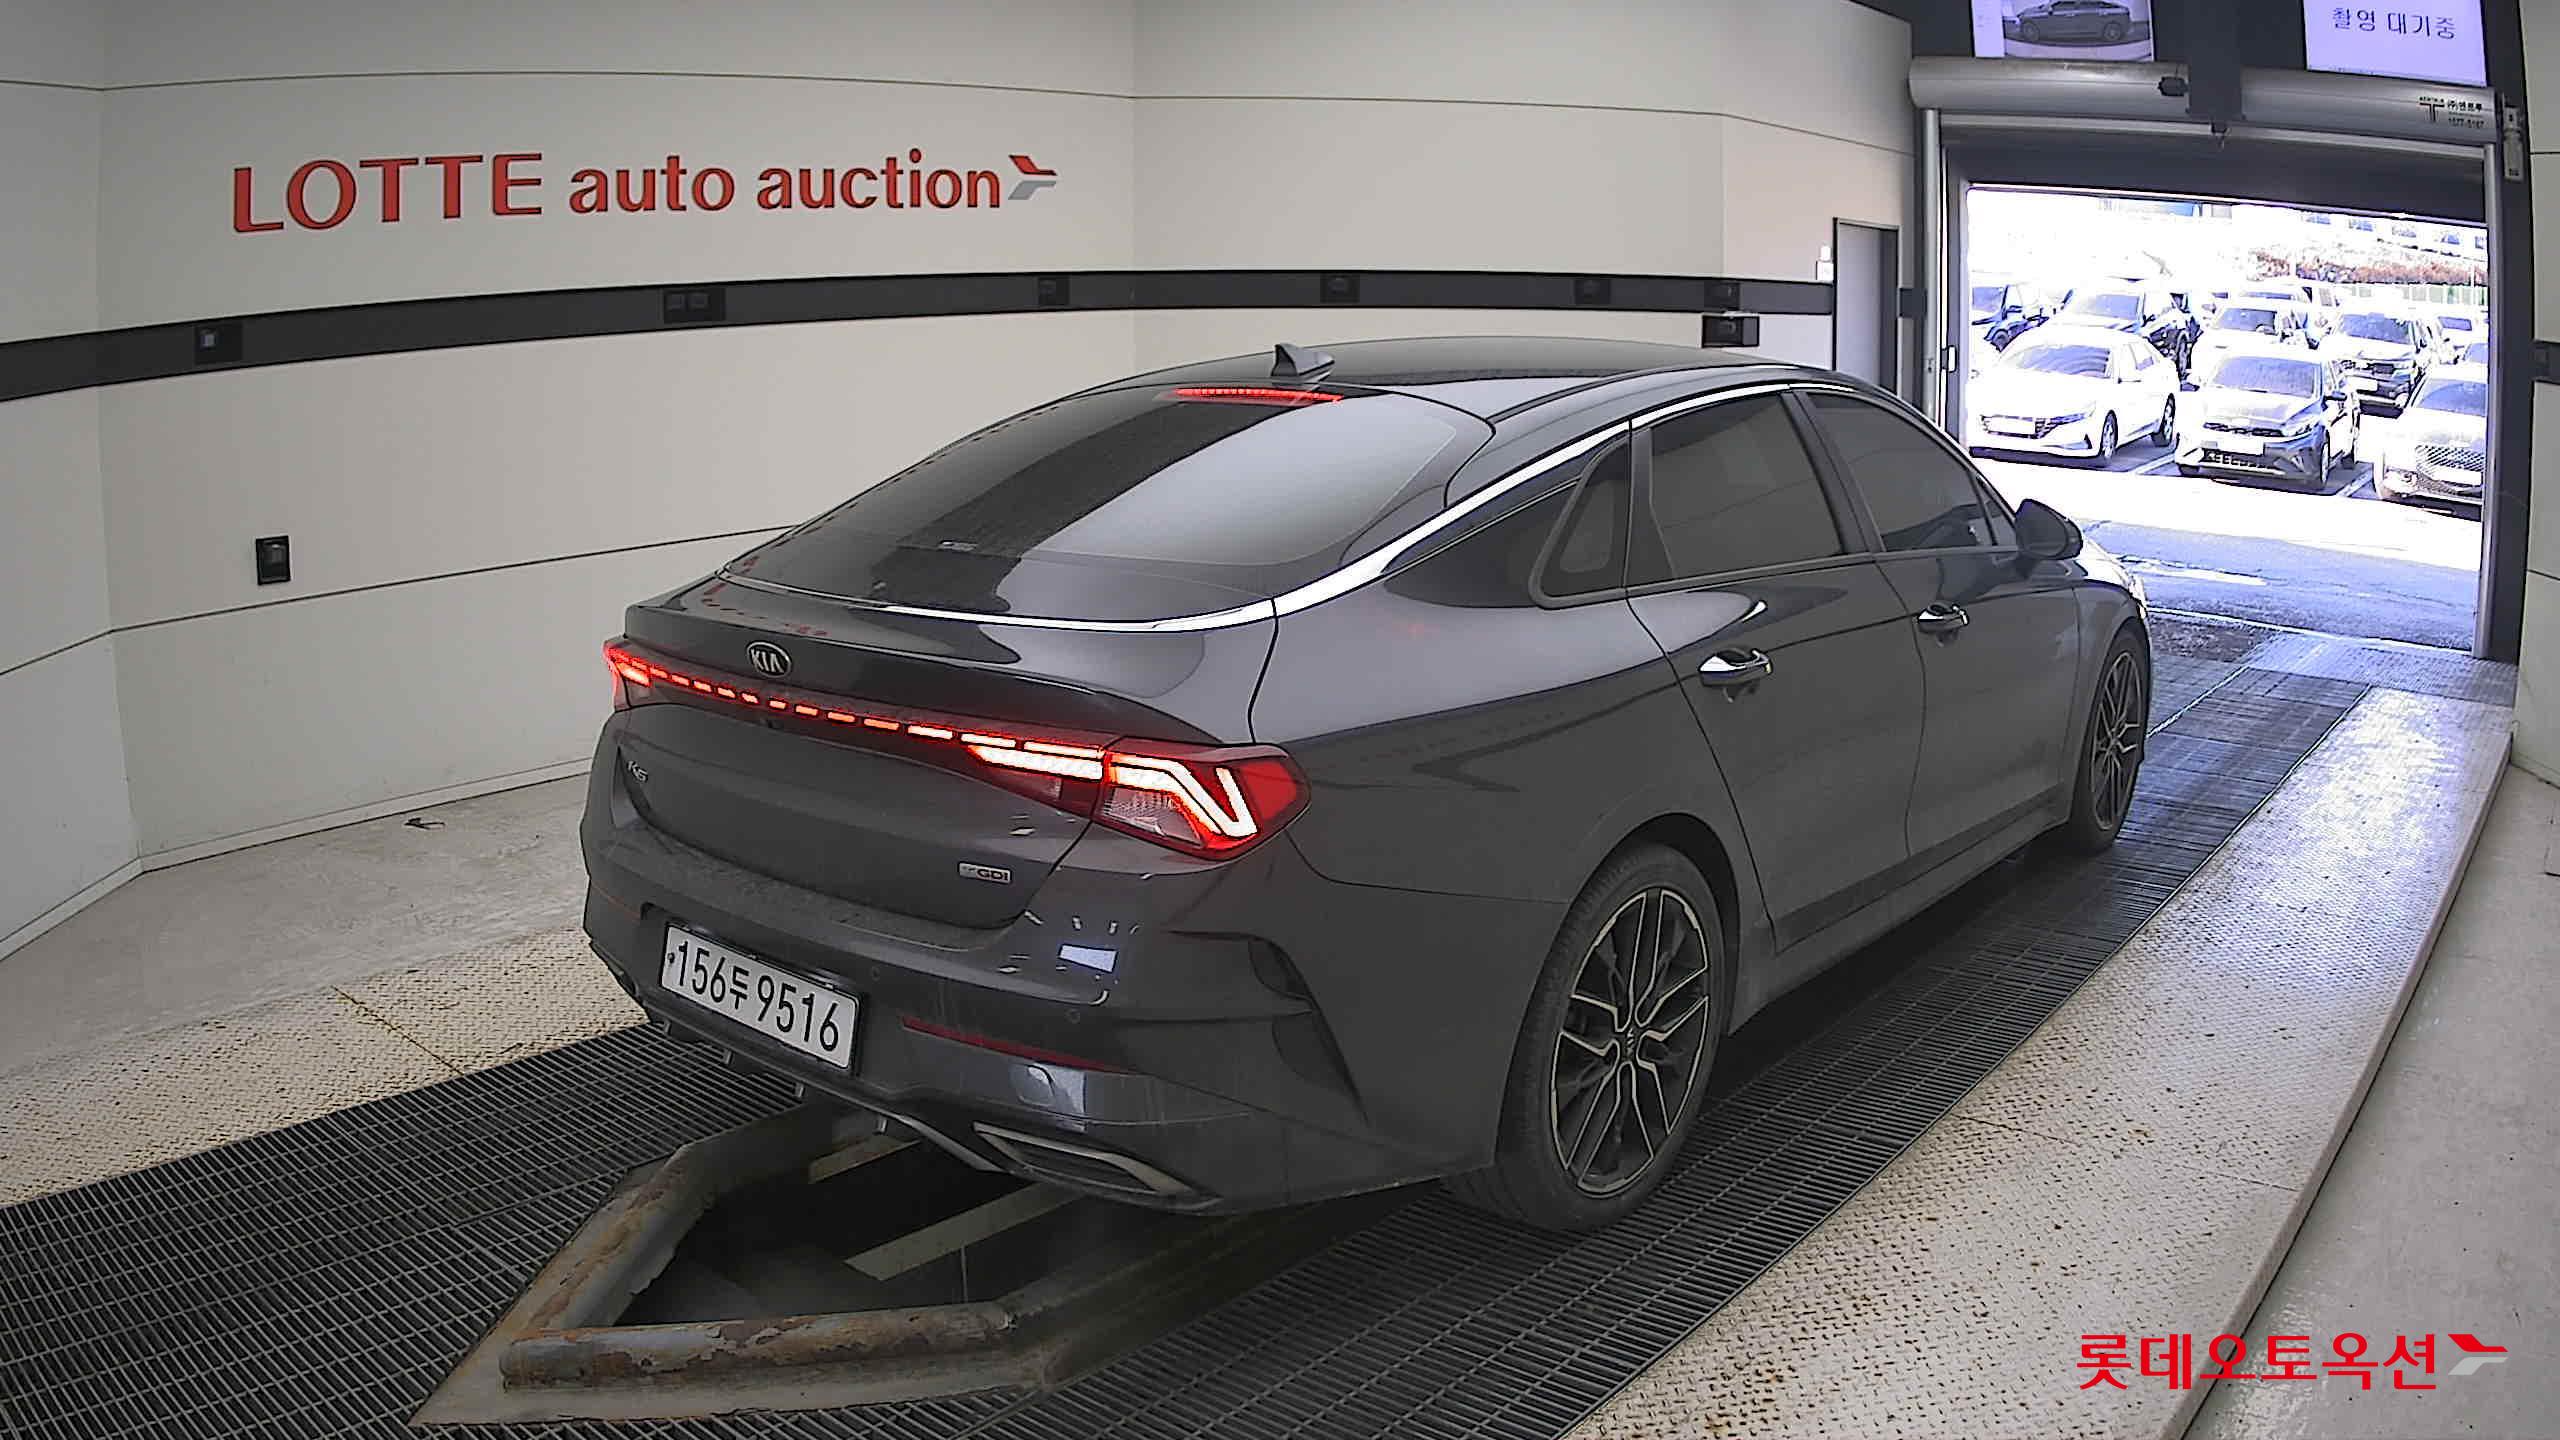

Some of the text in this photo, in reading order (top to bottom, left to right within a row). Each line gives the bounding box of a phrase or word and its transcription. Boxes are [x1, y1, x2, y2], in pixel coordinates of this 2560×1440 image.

[2332, 7, 2457, 40] 촬영 대기중
[233, 148, 1001, 233] LOTTE auto auction
[750, 648, 785, 673] KIA
[678, 940, 840, 1052] 156두 9516
